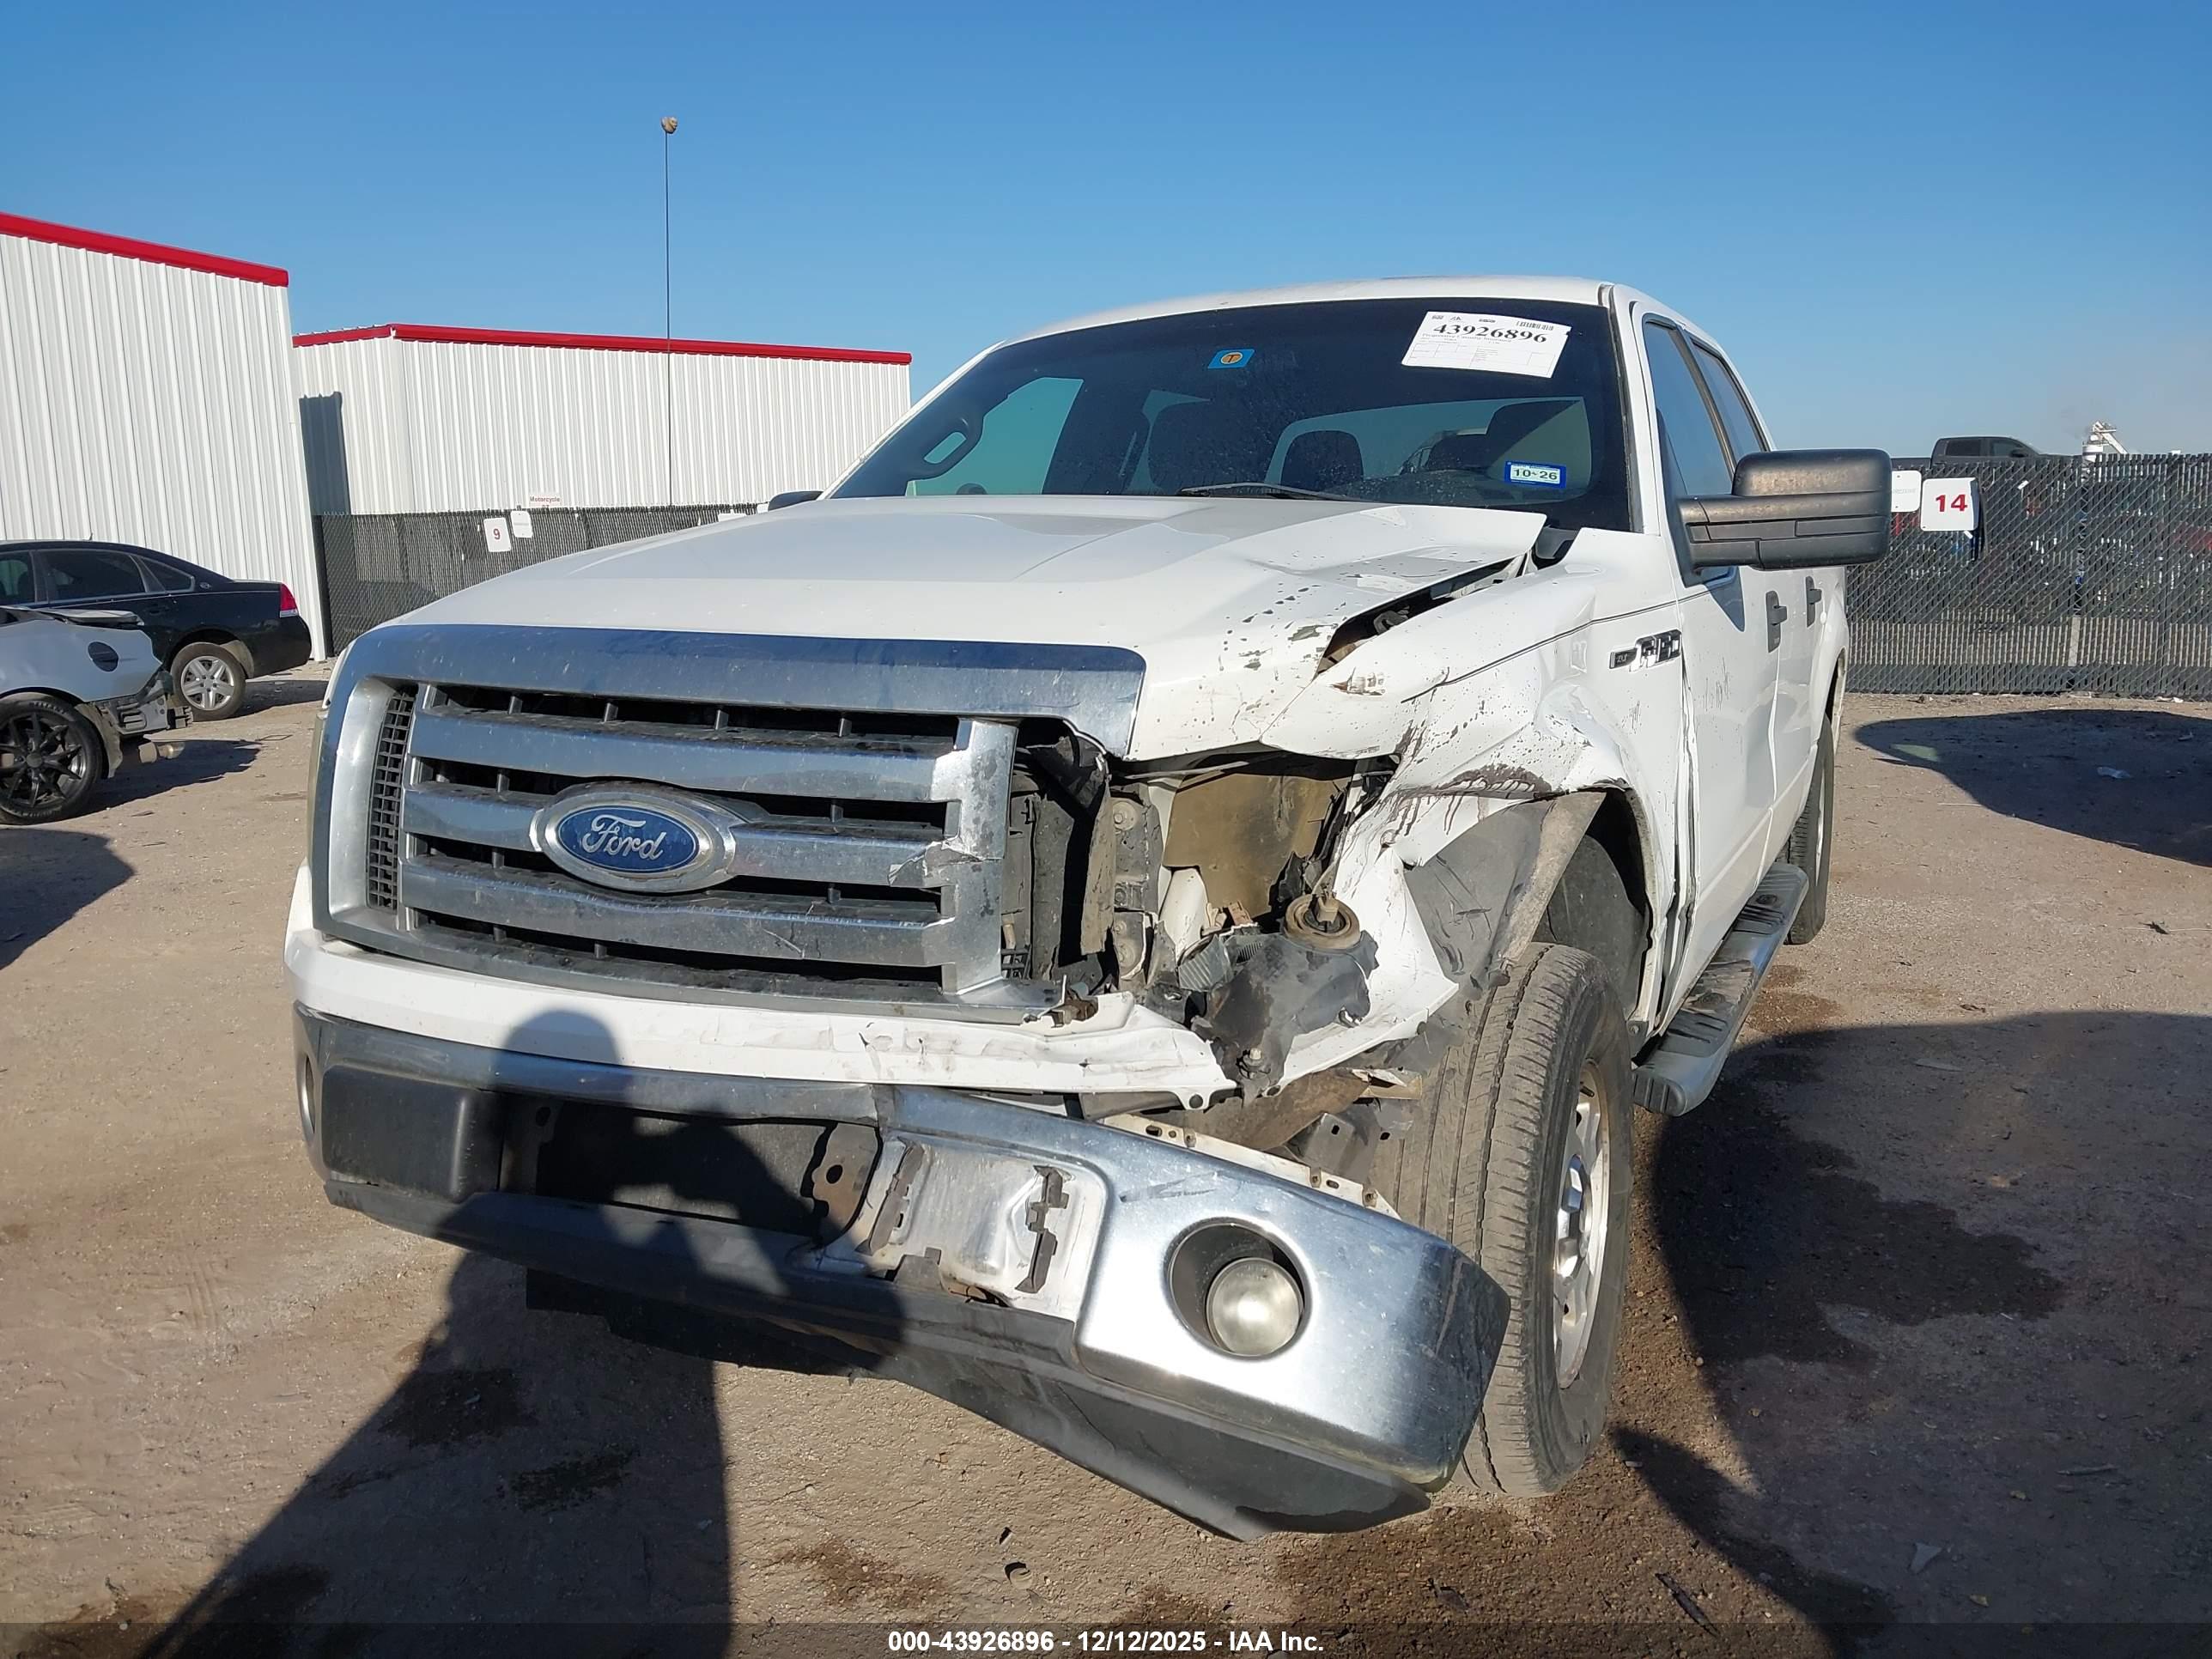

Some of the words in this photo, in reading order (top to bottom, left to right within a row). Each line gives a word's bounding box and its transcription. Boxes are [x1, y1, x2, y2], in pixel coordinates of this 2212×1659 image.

[1432, 323, 1549, 343] 43926896
[1935, 494, 1968, 513] 14
[493, 528, 501, 540] 9
[581, 814, 667, 860] Ford
